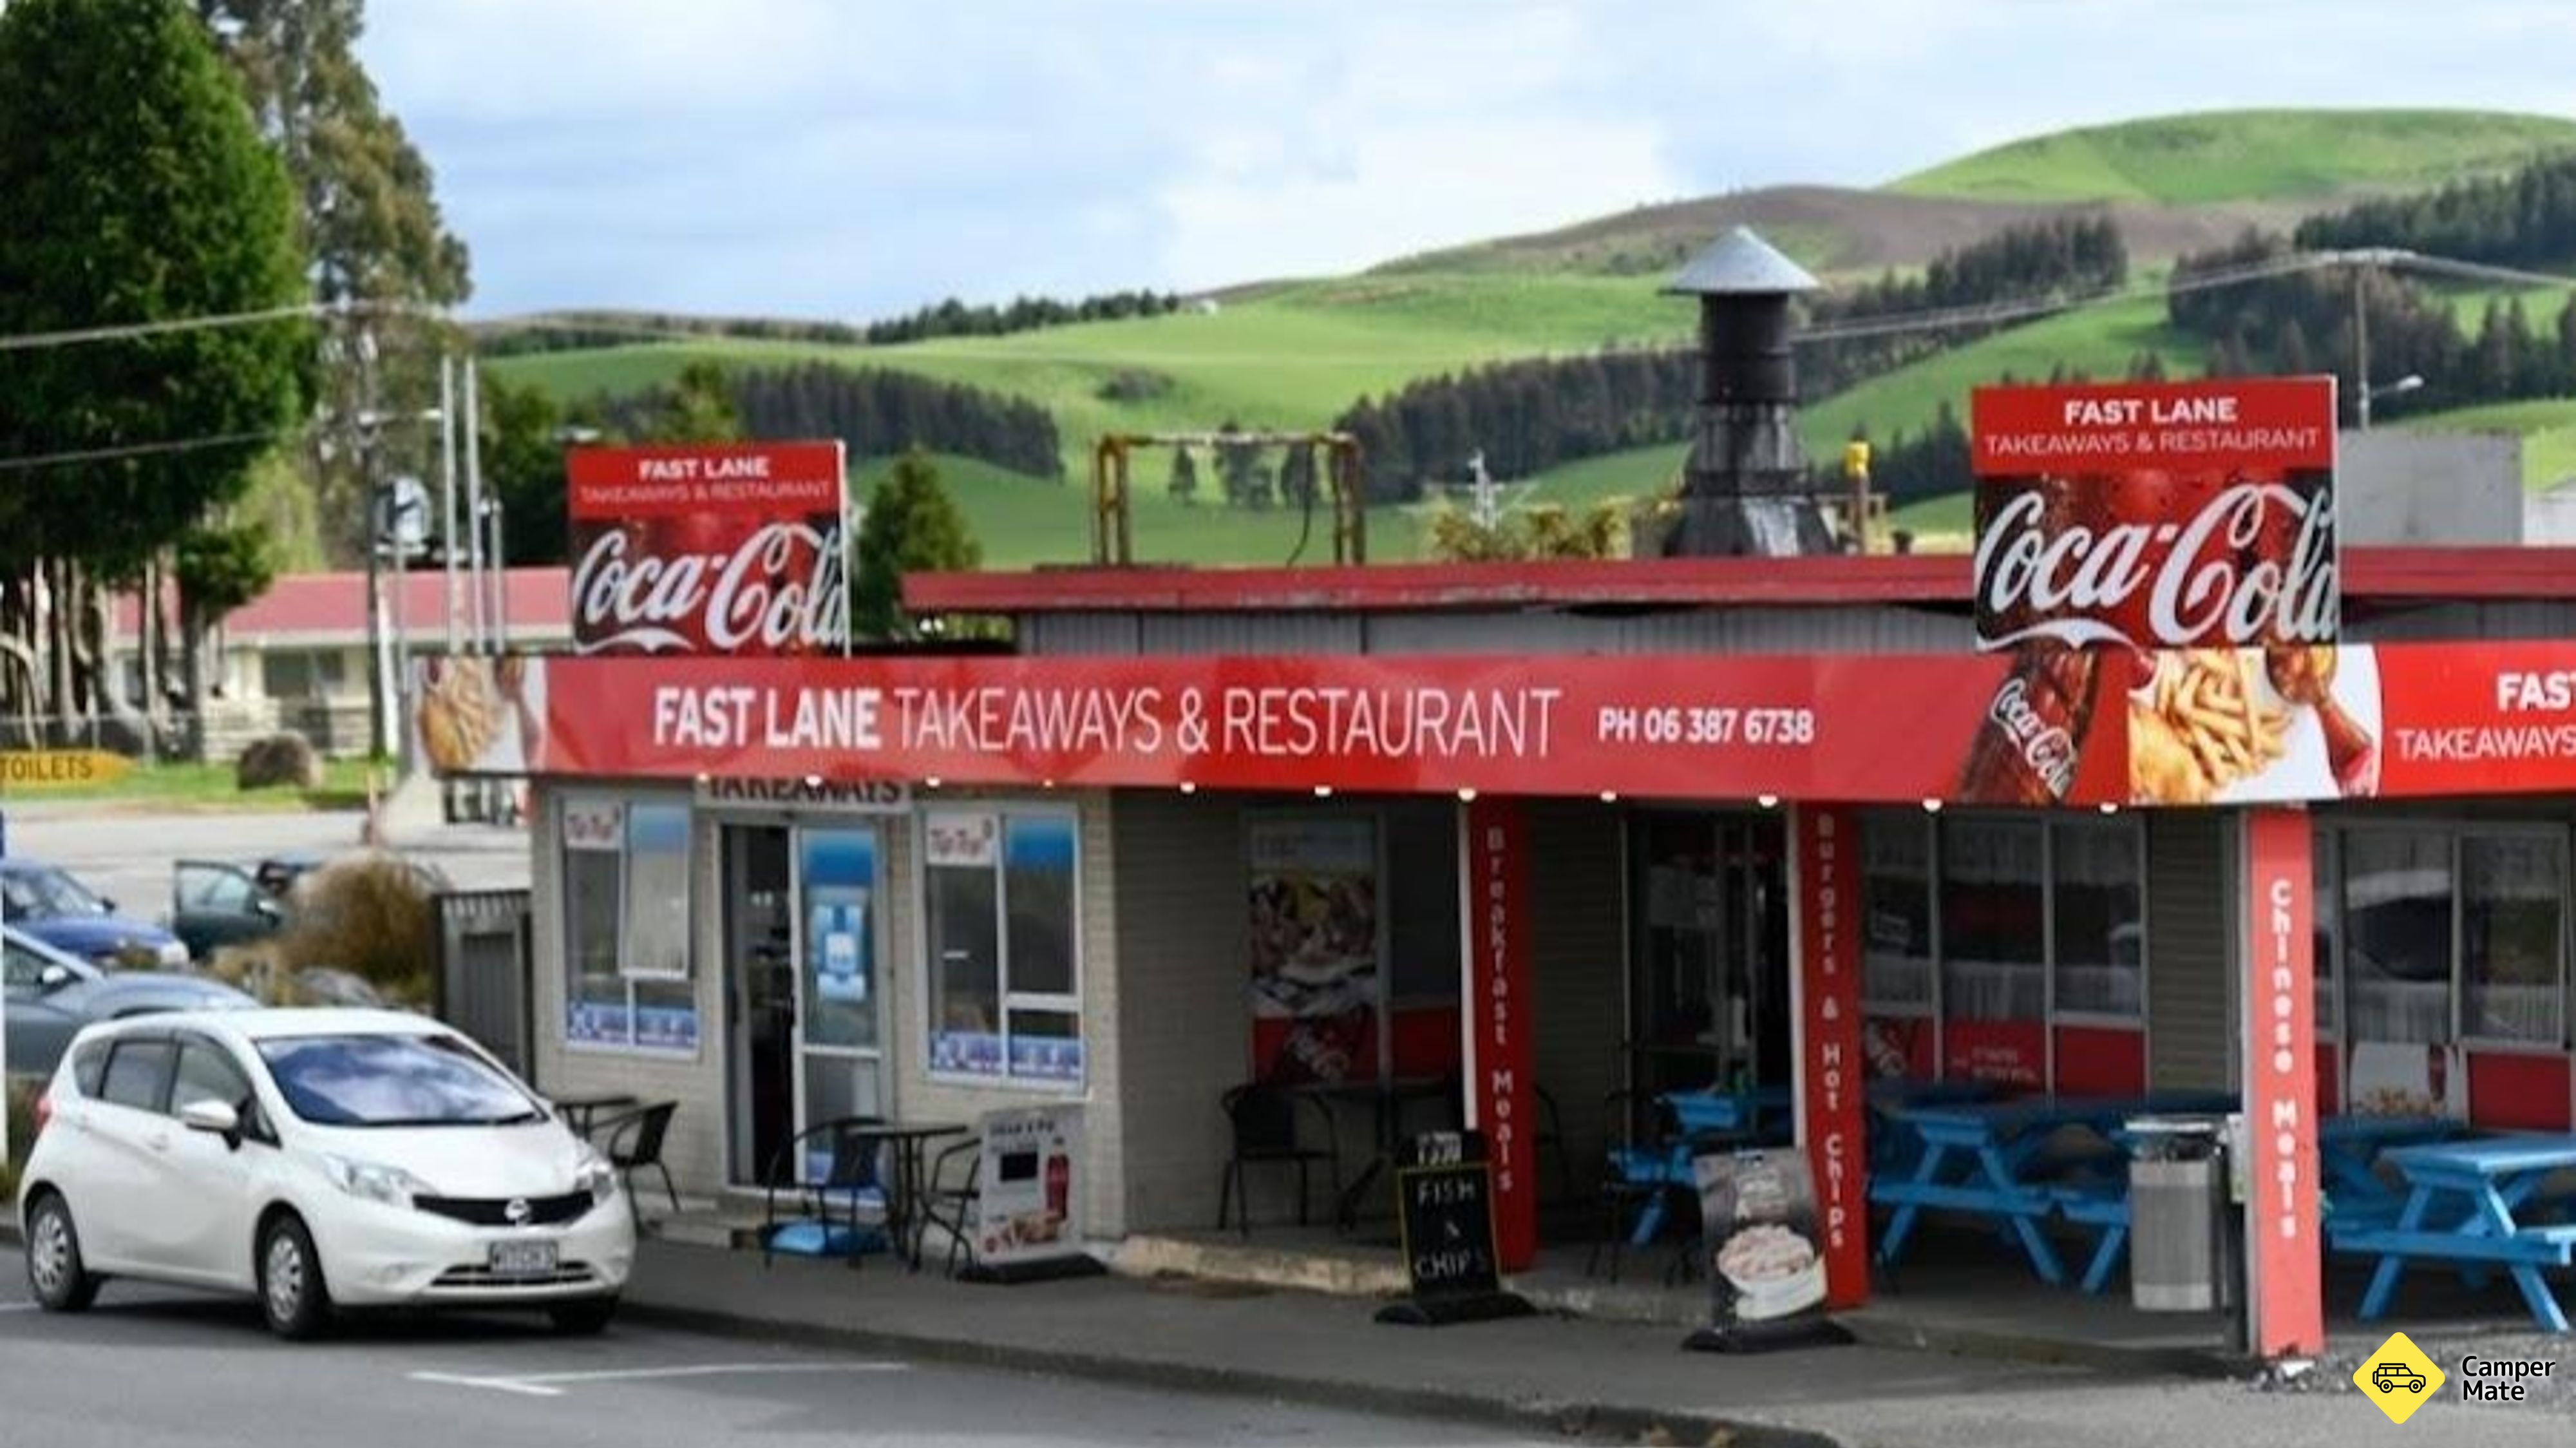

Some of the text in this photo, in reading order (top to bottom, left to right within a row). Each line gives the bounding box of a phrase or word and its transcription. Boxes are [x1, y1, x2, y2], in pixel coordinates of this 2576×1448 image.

[2064, 397, 2237, 425] FAST LANE
[639, 456, 770, 480] FAST LANE
[1985, 427, 2318, 455] TAKEAWAYS & RESTAURANT
[580, 480, 829, 503] TAKEAWAYS & RESTAURANT
[573, 521, 847, 654] Coca-Cola
[1975, 483, 2337, 652] Coca-Cola
[2497, 671, 2576, 712] FAS
[653, 687, 1815, 756] FAST LANE TAKEAWAYS & RESTAURANT PH 06 387 6738
[2395, 724, 2576, 761] TAKEAWAYS
[1822, 1041, 1841, 1111] Hot
[2270, 878, 2298, 1239] Chinese Meals
[1491, 1069, 1514, 1192] Meals
[1417, 1177, 1476, 1206] FISH
[1824, 1132, 1846, 1248] Chips
